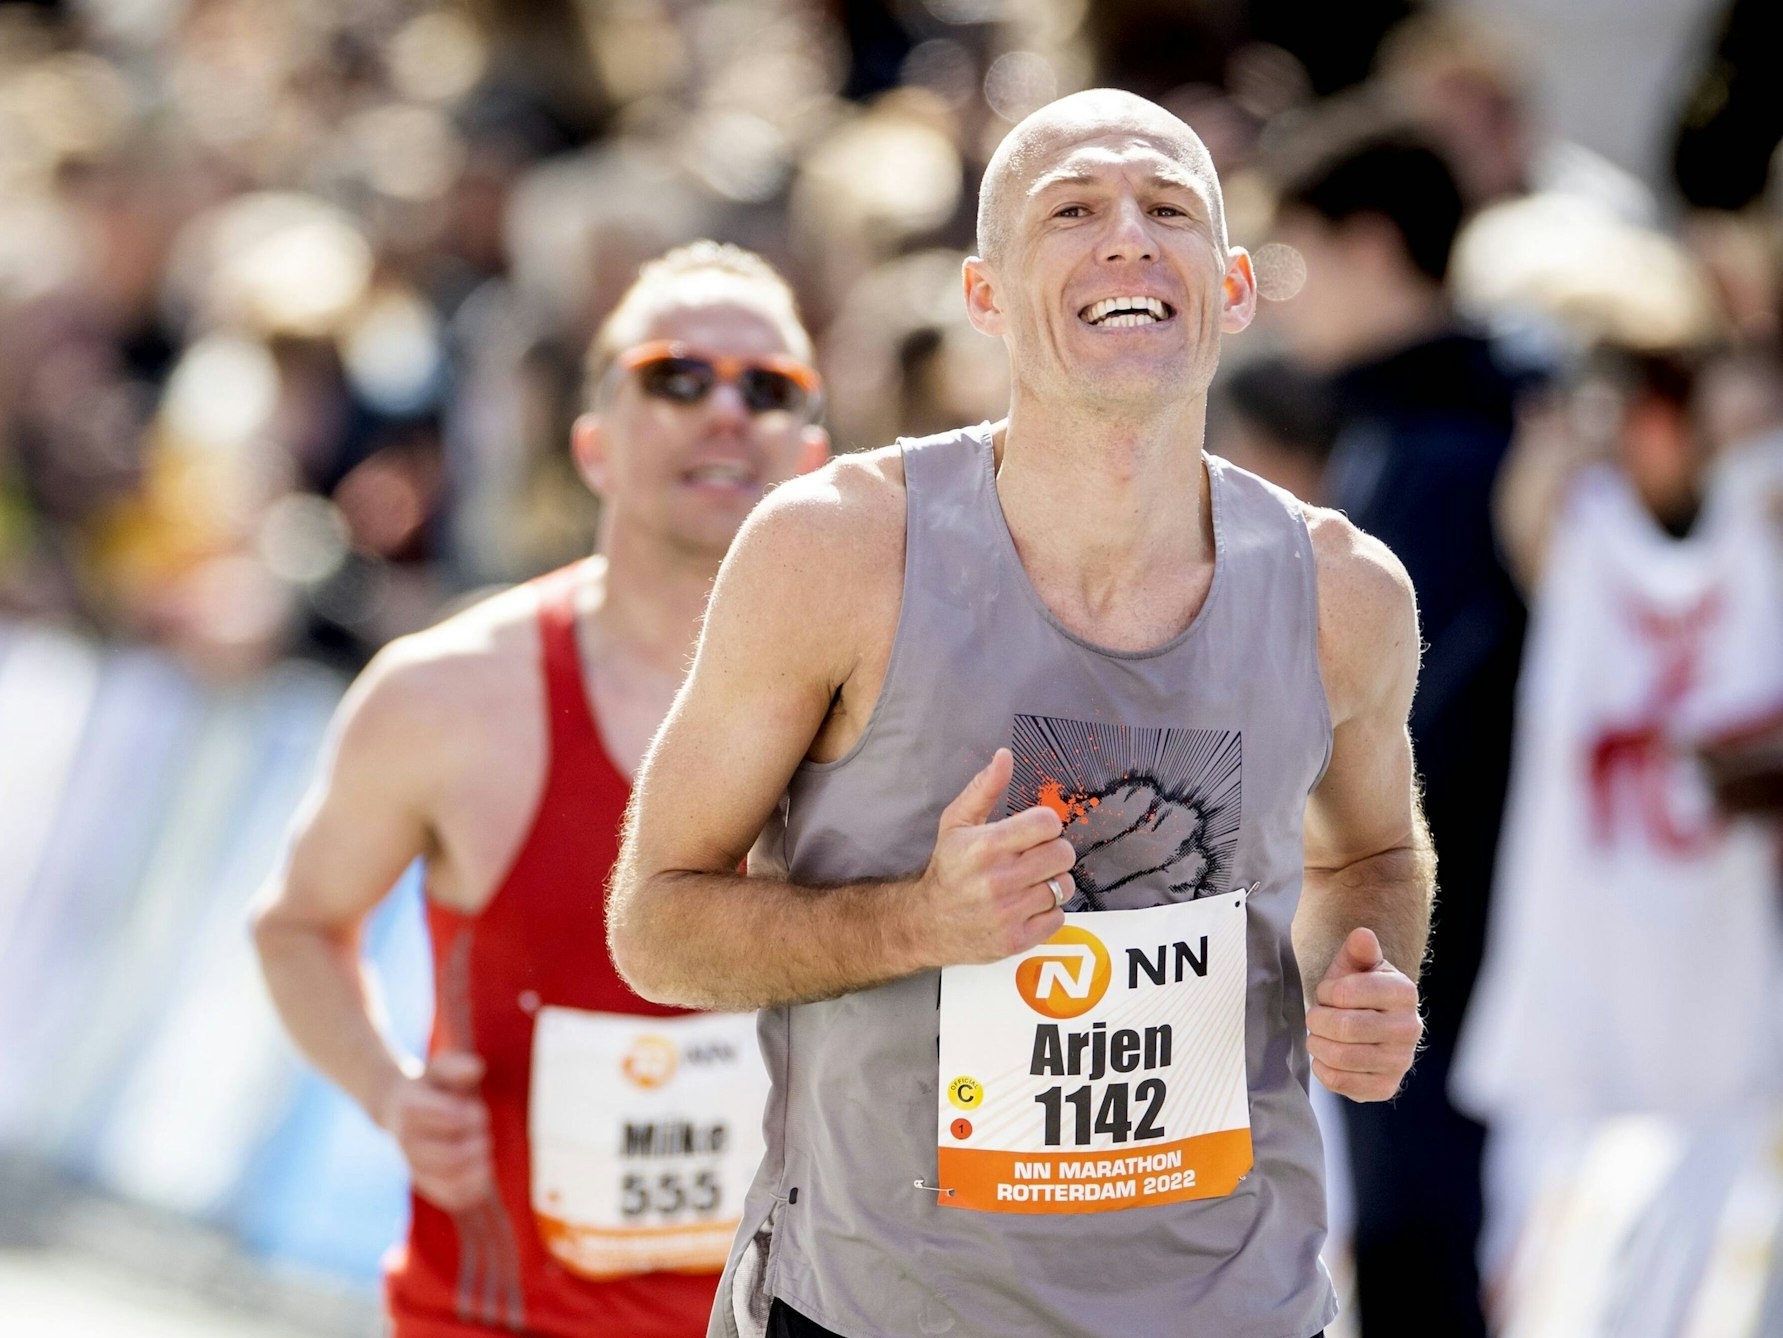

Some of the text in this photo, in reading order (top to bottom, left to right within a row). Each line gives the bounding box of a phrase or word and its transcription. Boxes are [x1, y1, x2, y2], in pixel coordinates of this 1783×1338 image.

[1125, 935, 1208, 989] NN
[1029, 1022, 1172, 1080] Arjen
[950, 1077, 979, 1091] OFFICIAL
[957, 1084, 974, 1103] C
[1034, 1078, 1167, 1145] 1142
[958, 1124, 965, 1134] 1
[1014, 1150, 1182, 1179] NN MARATHON
[621, 1172, 721, 1217] 555
[997, 1170, 1196, 1201] ROTTERDAM 2022
